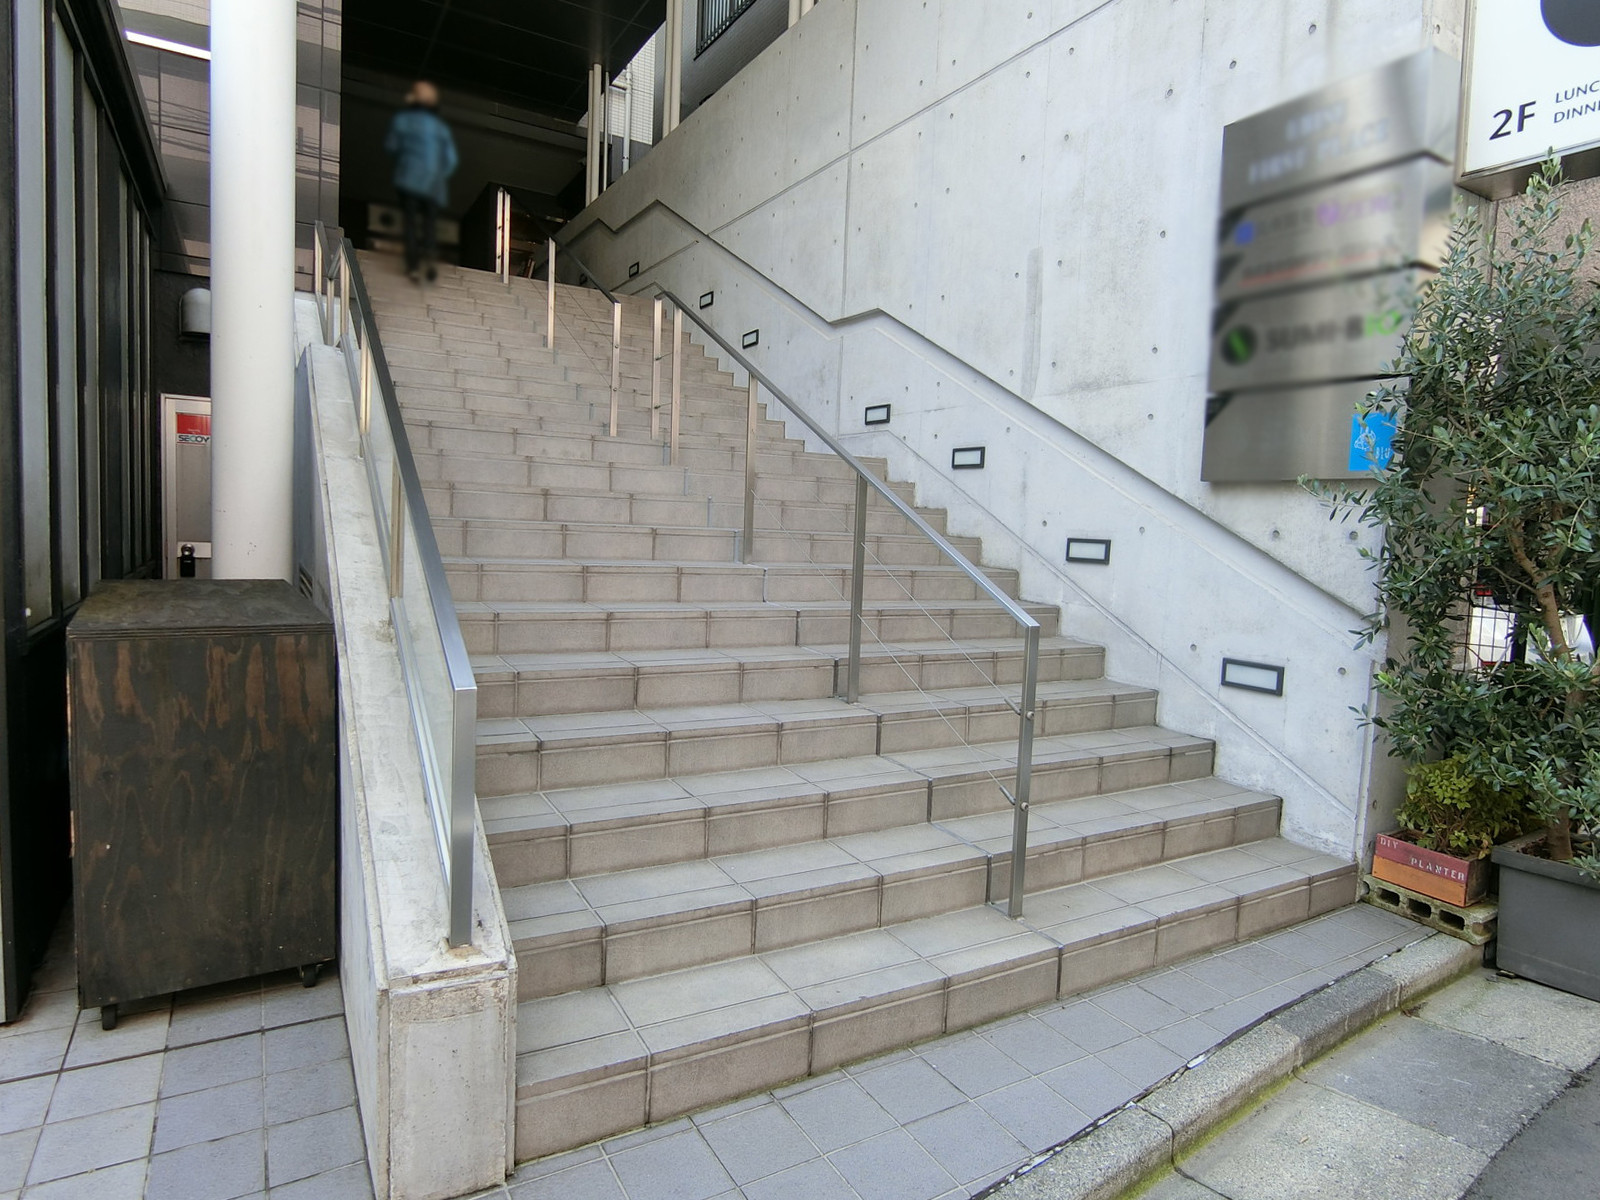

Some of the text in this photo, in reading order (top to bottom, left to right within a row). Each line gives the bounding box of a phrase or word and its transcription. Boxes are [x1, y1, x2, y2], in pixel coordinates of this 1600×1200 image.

[1489, 101, 1536, 140] 2F
[1553, 100, 1600, 124] DINN
[1380, 836, 1399, 849] DIY
[1411, 857, 1465, 881] PLANTER
